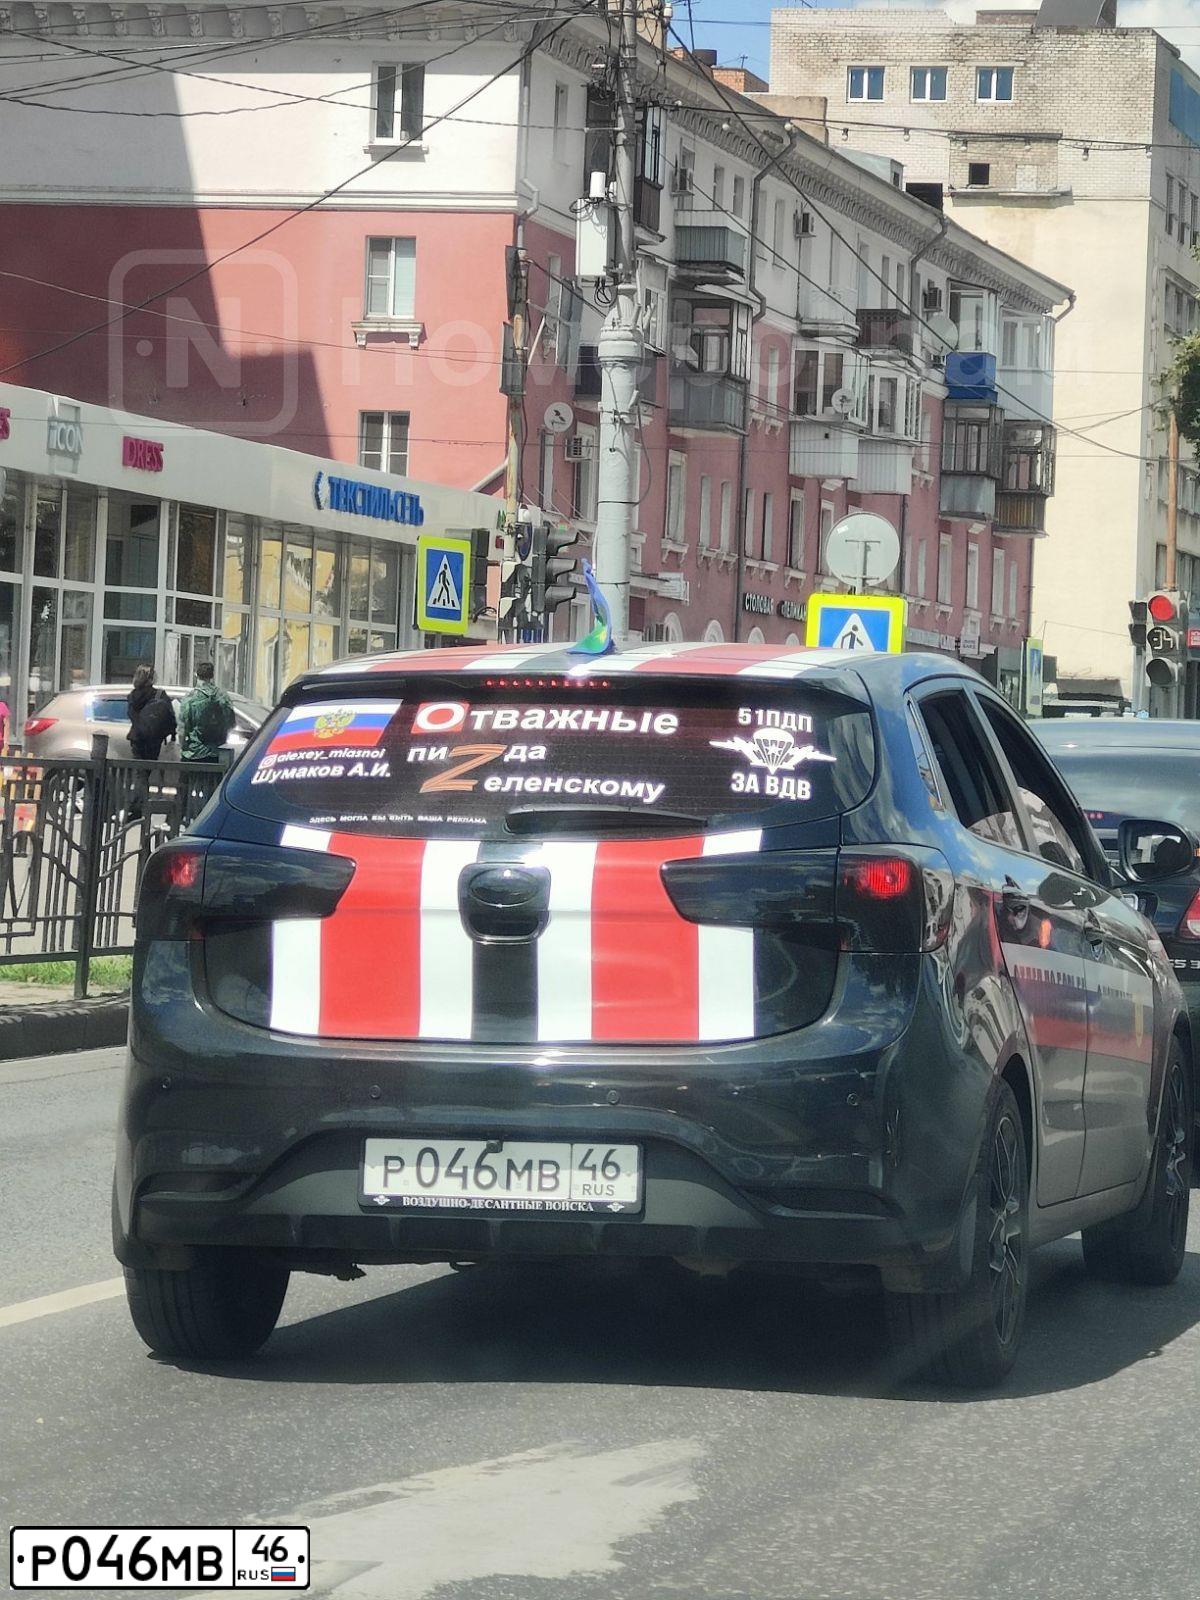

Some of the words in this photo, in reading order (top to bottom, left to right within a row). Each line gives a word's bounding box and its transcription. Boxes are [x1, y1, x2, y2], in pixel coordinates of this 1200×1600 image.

[122, 436, 165, 472] DRESS
[327, 475, 424, 527] ТЕКСТИЛЬСЕТЬ
[416, 702, 680, 735] Отважные
[251, 765, 345, 785] Шумаков
[730, 772, 760, 794] ЗА
[765, 775, 812, 800] ВДВ
[340, 815, 368, 823] МОГЛА
[417, 815, 443, 823] ВАША
[578, 1148, 621, 1181] 46
[402, 1196, 543, 1211] ВОЗДУШНО-ДЕСАНТНЫЕ
[582, 1183, 617, 1197] RUS
